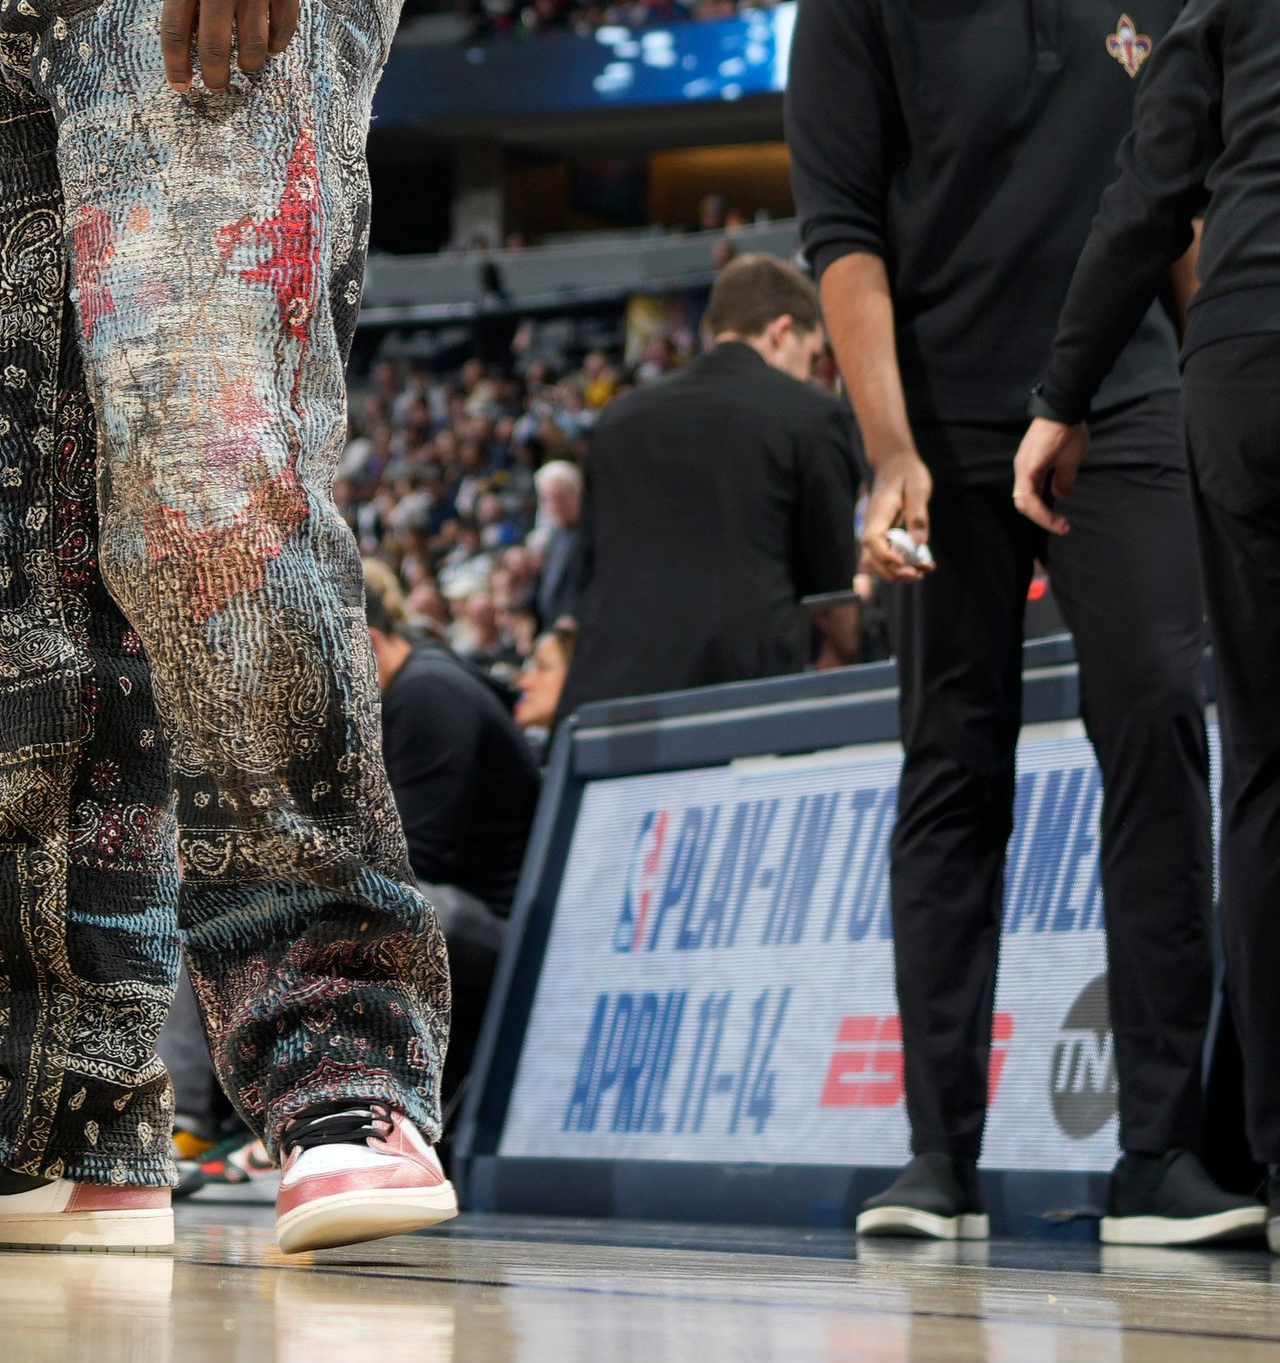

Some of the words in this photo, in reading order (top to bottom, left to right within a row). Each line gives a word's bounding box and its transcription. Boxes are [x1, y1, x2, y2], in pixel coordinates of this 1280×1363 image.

[646, 790, 841, 953] PLAY-IN
[561, 987, 689, 1134] APRIL
[670, 984, 795, 1135] 11-14
[1054, 1028, 1118, 1093] TN
